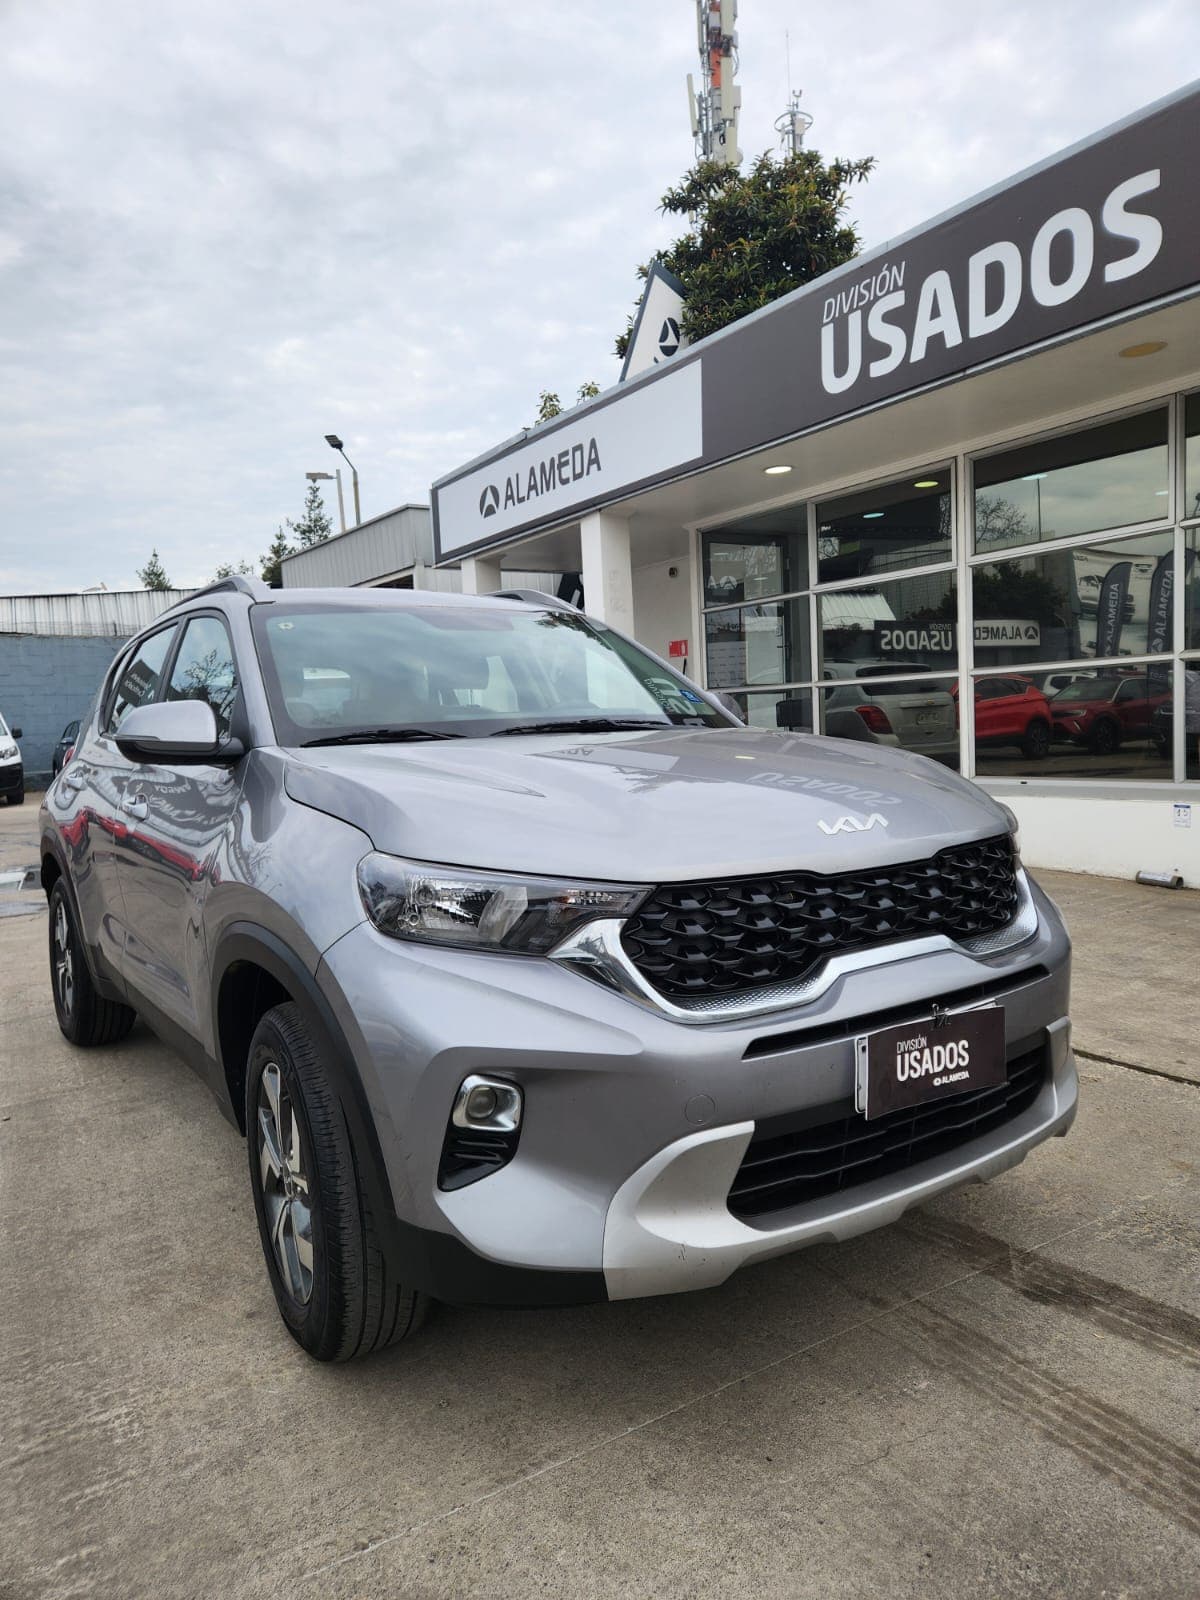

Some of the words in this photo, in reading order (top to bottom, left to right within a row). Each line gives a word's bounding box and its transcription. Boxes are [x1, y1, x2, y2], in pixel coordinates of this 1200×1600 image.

[821, 168, 1163, 395] USADOS
[823, 261, 905, 324] DIVISIÓN
[504, 437, 602, 510] ALAMEDA
[1106, 583, 1120, 641] ALAMEDA
[896, 1034, 927, 1054] DIVISIÓN
[896, 1040, 969, 1082] USADOS
